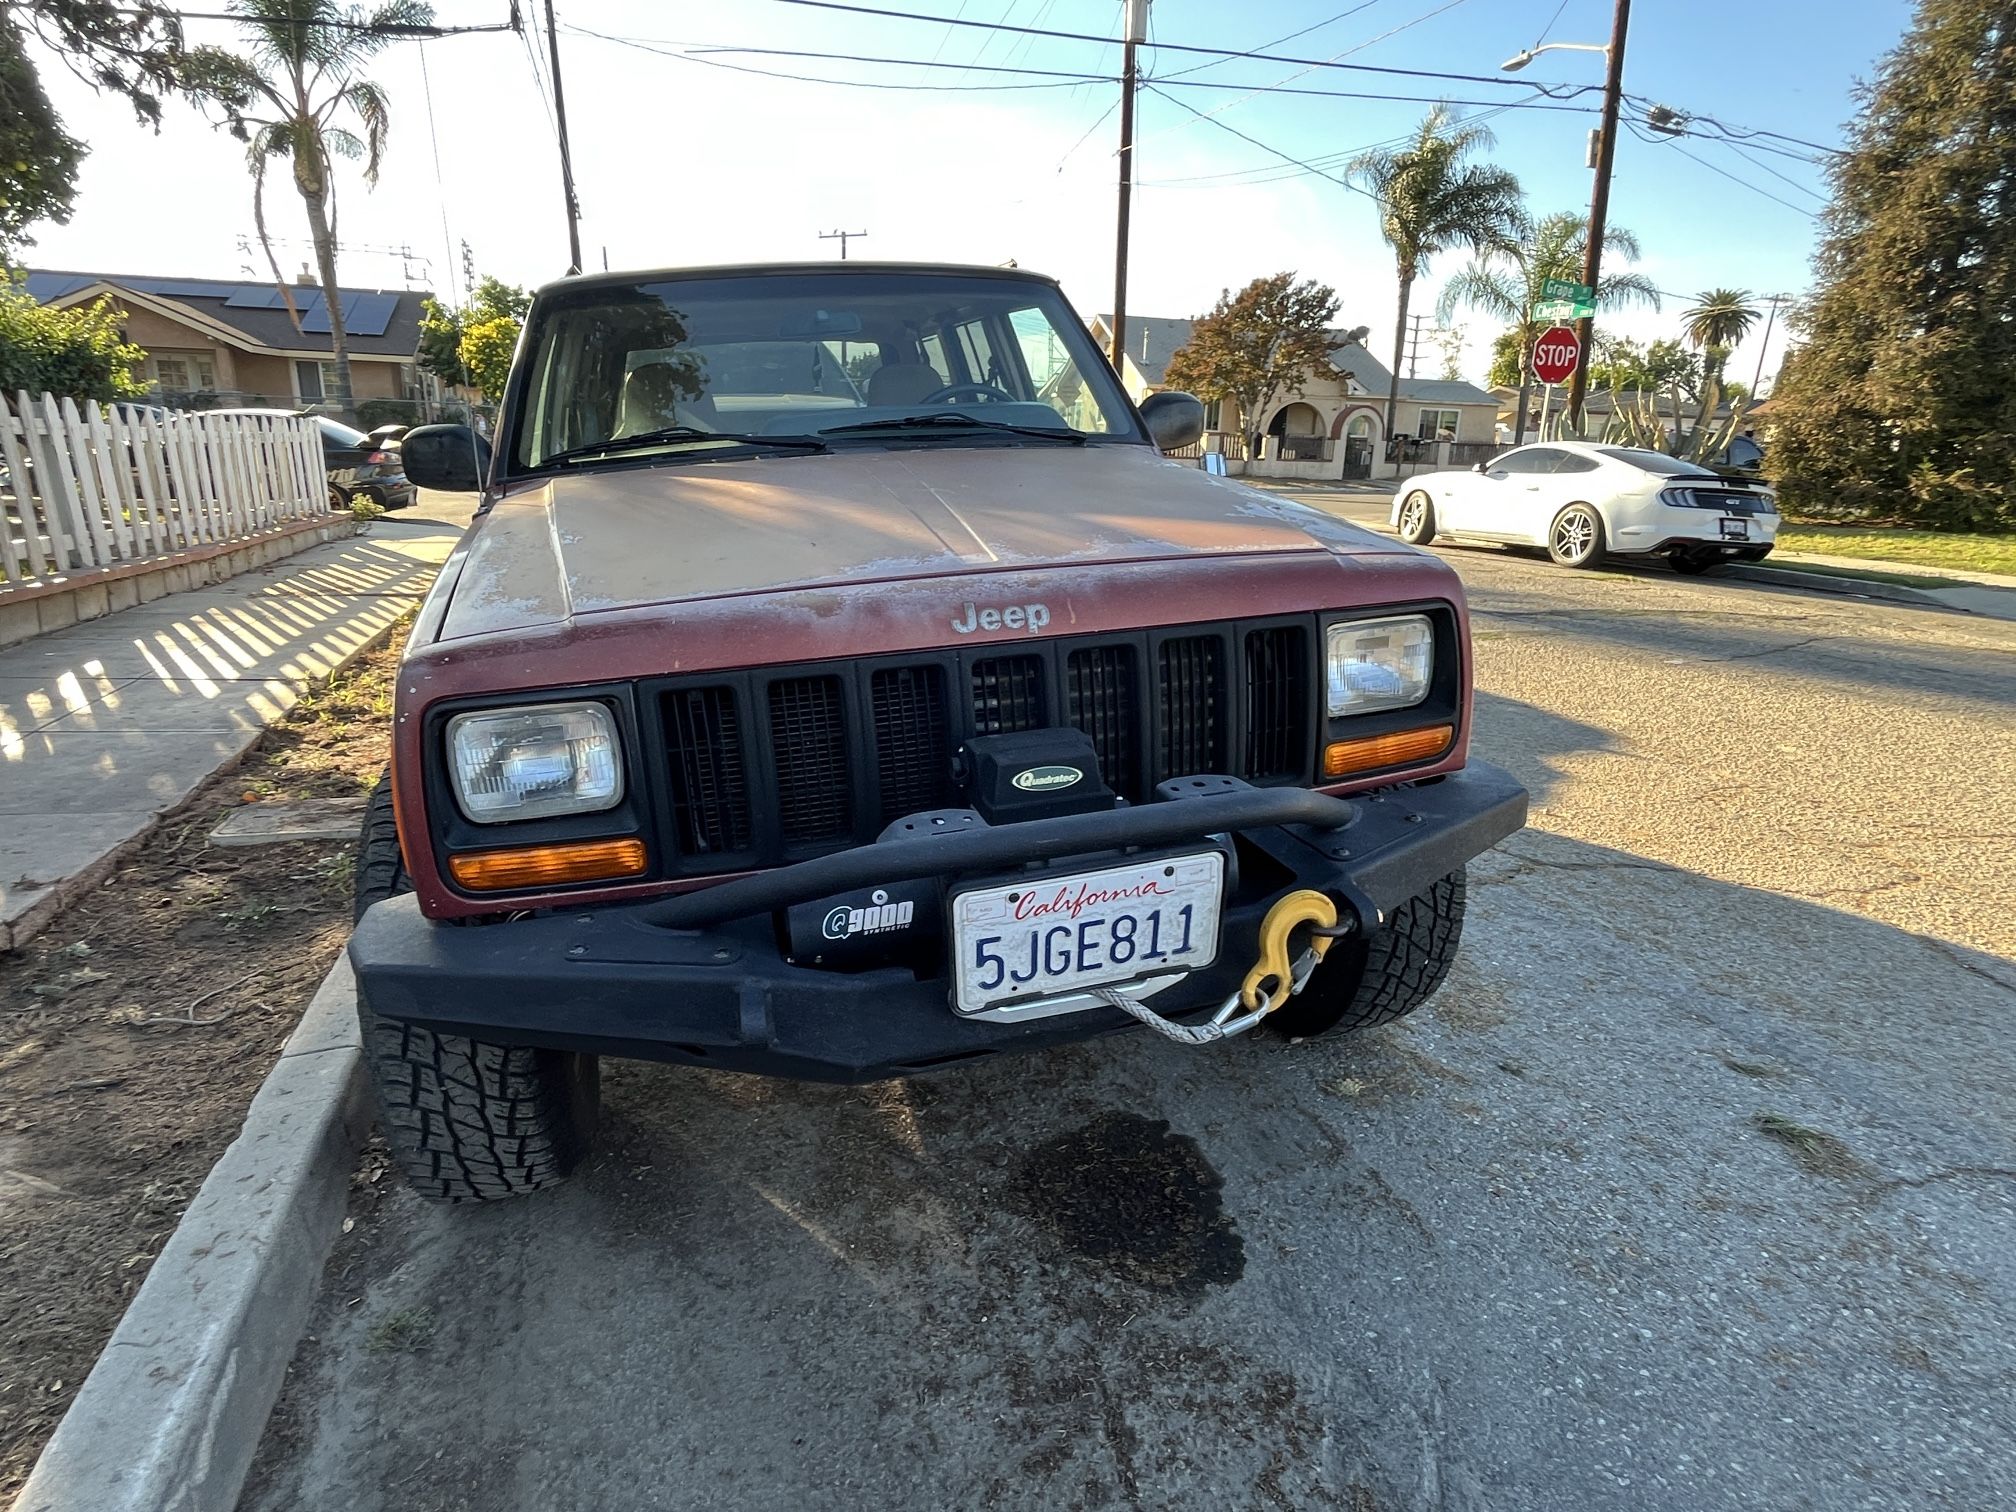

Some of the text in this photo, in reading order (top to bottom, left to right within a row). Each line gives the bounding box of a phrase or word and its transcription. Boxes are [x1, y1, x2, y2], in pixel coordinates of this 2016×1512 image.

[1546, 280, 1574, 298] Grape
[1536, 344, 1576, 367] STOP
[951, 602, 1050, 634] Jeep
[1020, 772, 1077, 787] Quadratec
[1015, 876, 1175, 920] California
[822, 901, 914, 939] Q9000
[863, 923, 910, 935] SYNTHETIC
[975, 903, 1193, 990] 5JGE811
